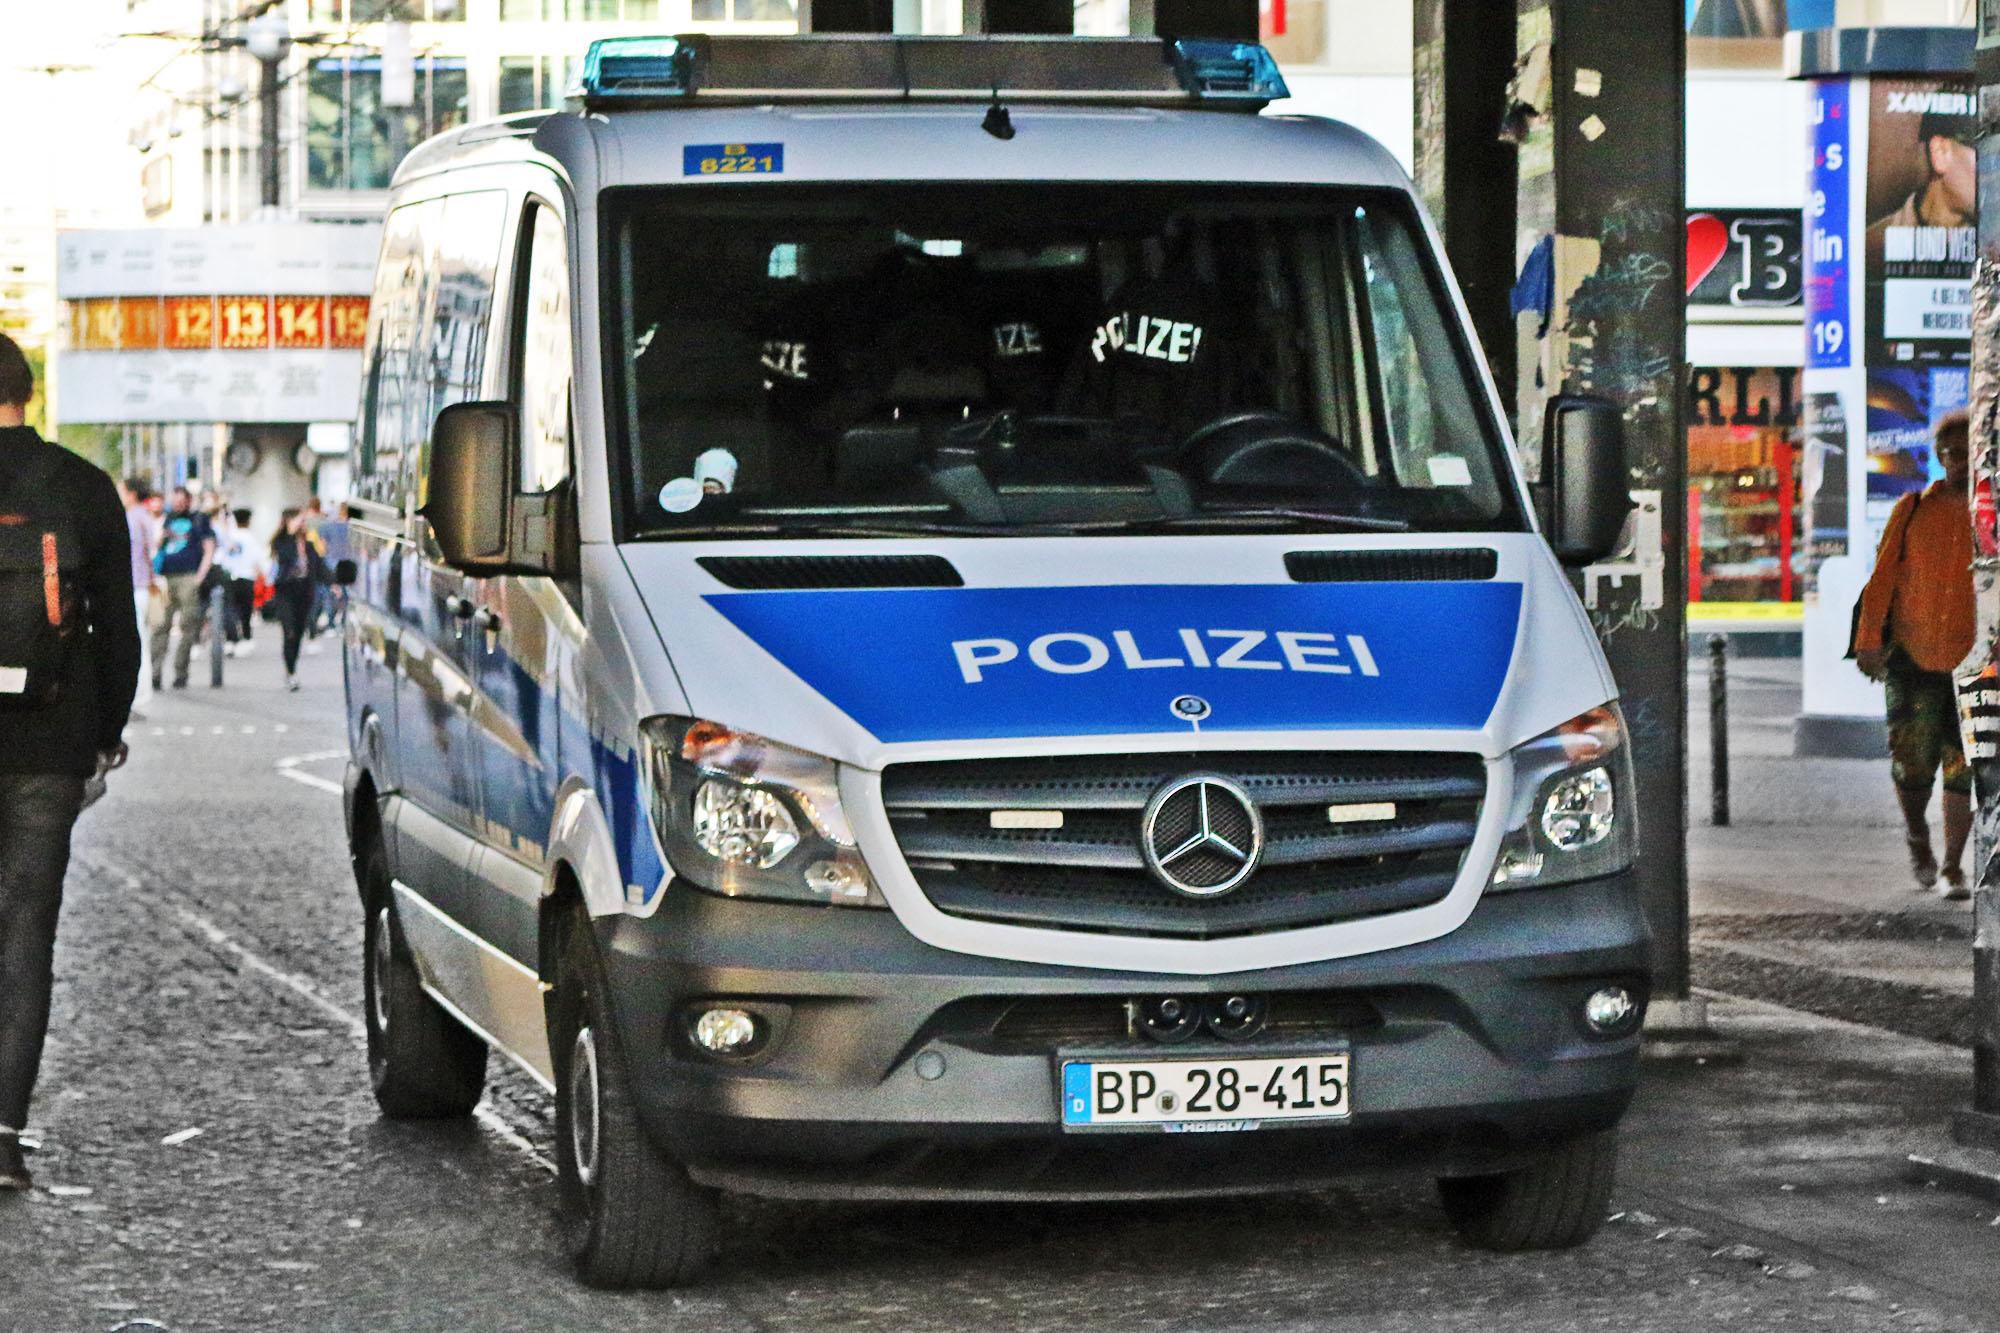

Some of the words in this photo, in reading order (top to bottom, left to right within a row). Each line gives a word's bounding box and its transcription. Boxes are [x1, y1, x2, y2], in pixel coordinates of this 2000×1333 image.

[700, 156, 773, 174] 8221
[175, 302, 212, 338] 12
[223, 301, 266, 338] 13
[278, 300, 319, 338] 14
[1813, 319, 1844, 355] 19
[952, 629, 1380, 684] POLIZEI
[1072, 1099, 1085, 1113] D
[1097, 1070, 1157, 1114] BP
[1186, 1064, 1343, 1113] 28-415
